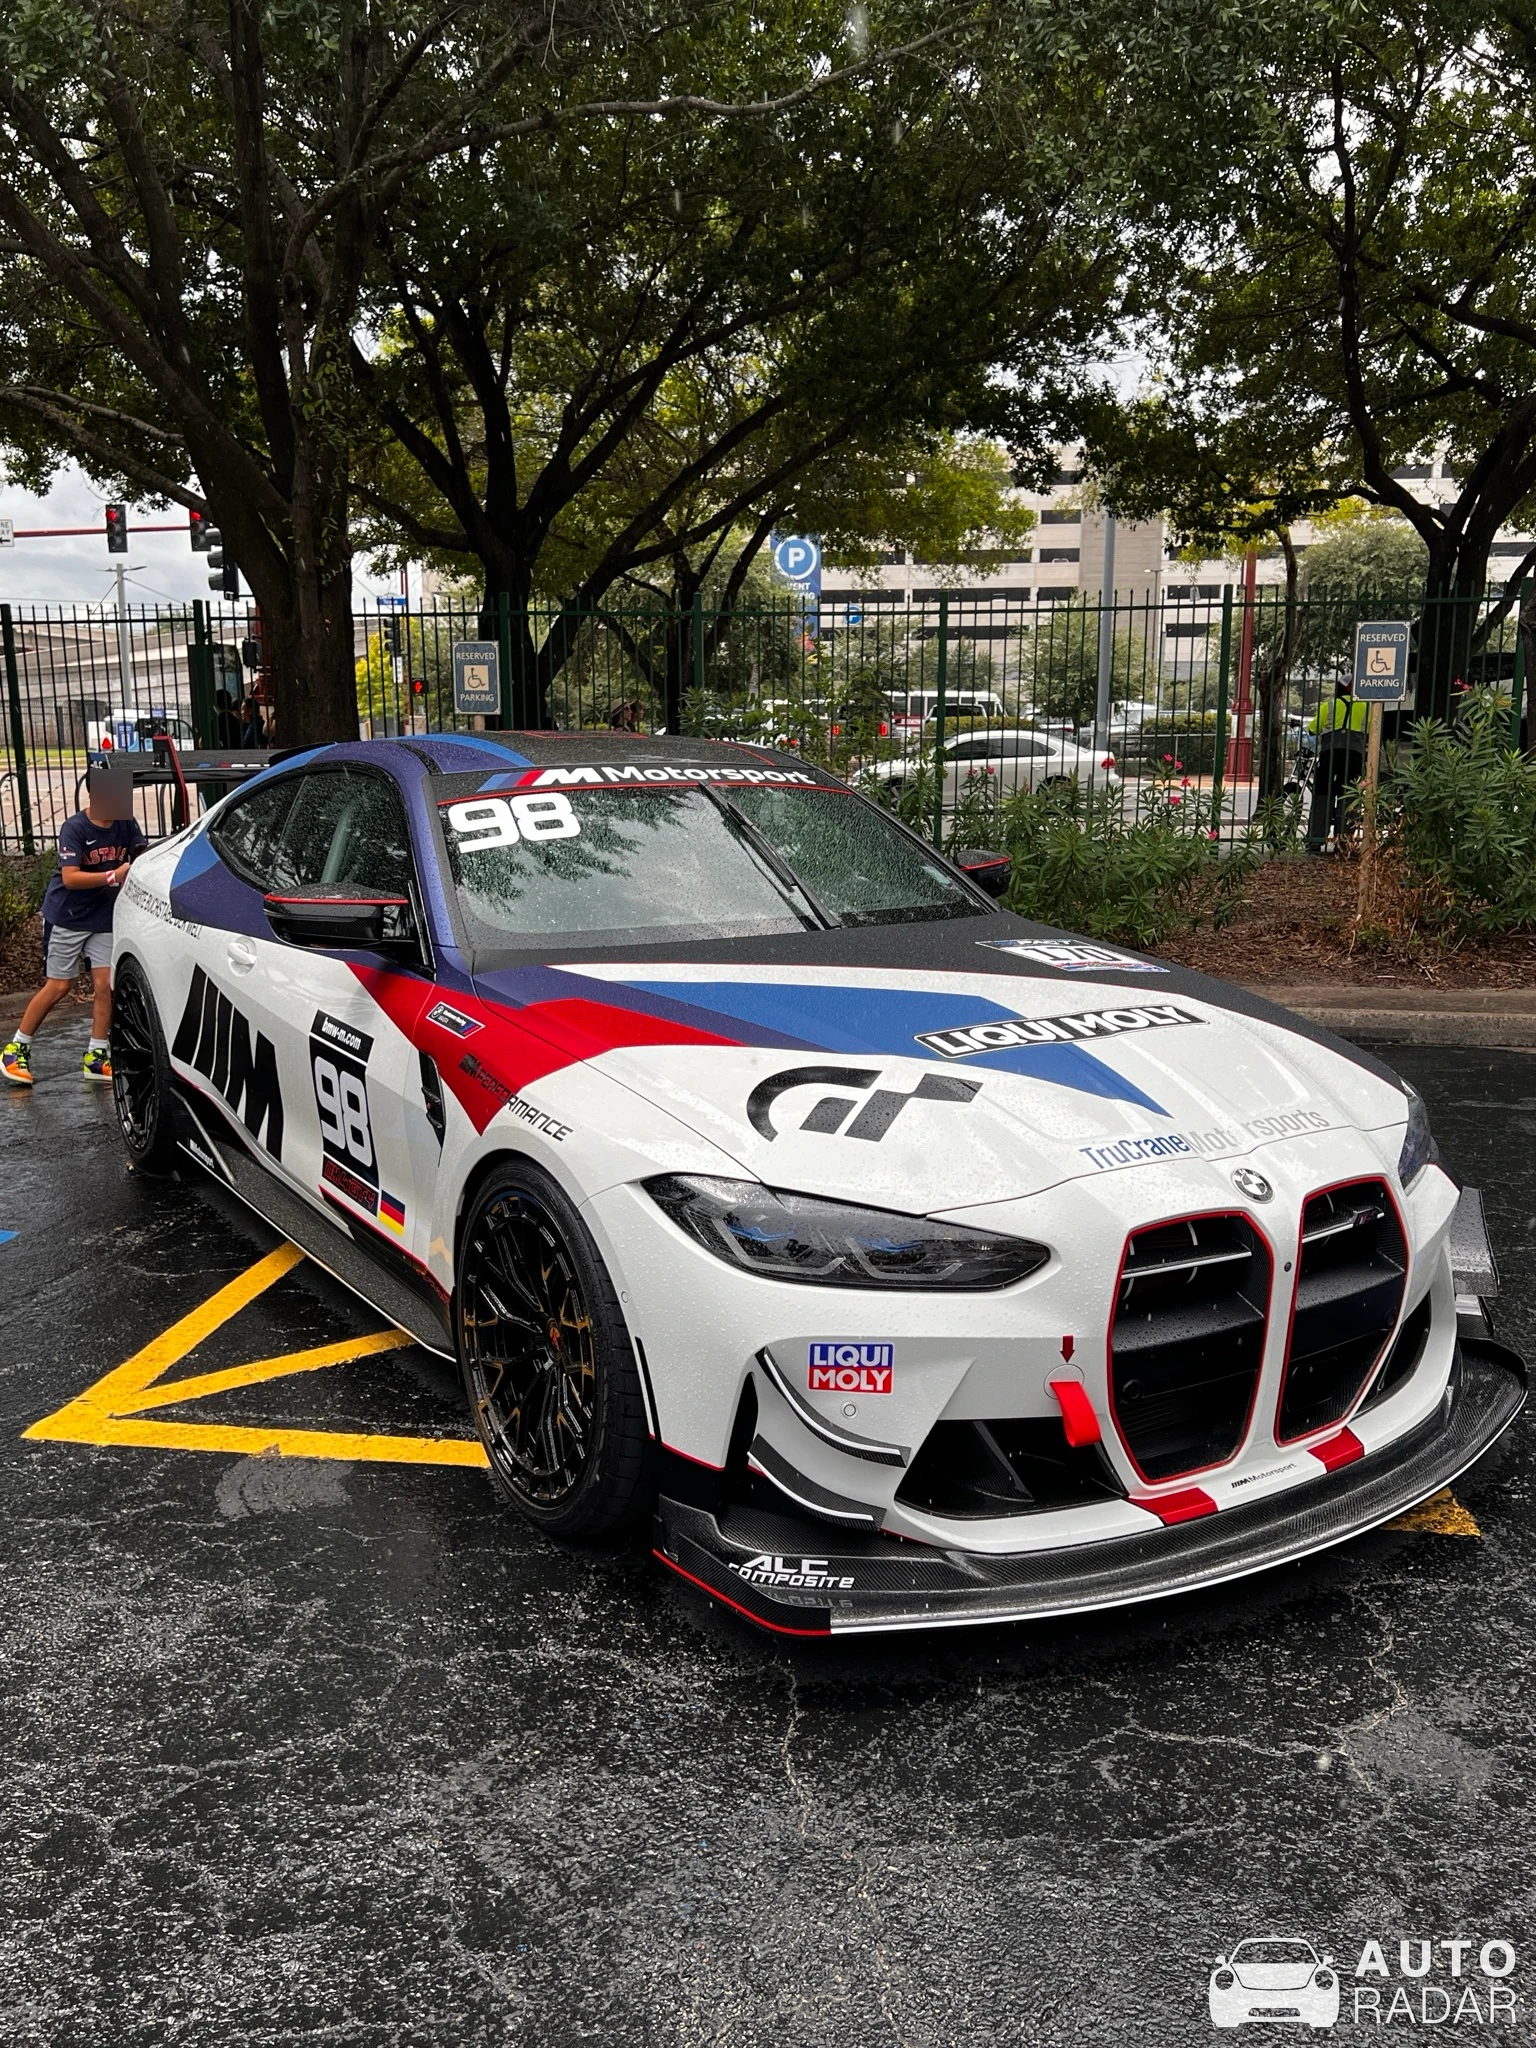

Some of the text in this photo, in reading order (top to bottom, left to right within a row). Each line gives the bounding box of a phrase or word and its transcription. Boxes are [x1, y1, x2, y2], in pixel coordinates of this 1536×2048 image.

[788, 547, 806, 568] P
[1360, 633, 1406, 642] RESERVED
[456, 652, 495, 660] RESERVED
[1360, 678, 1400, 687] PARKING
[460, 693, 494, 702] PARKING
[601, 766, 817, 786] Motorsport
[447, 792, 581, 854] 98
[1022, 946, 1122, 962] 170
[322, 1016, 363, 1051] bmw-m.com
[925, 1005, 1193, 1055] LIQUI MOLY
[314, 1055, 372, 1167] 98
[476, 1068, 574, 1142] PERFORMANCE
[813, 1345, 889, 1368] LIQUI
[812, 1368, 891, 1391] MOLY
[1247, 1462, 1298, 1483] Motorsport
[742, 1554, 829, 1576] ALC
